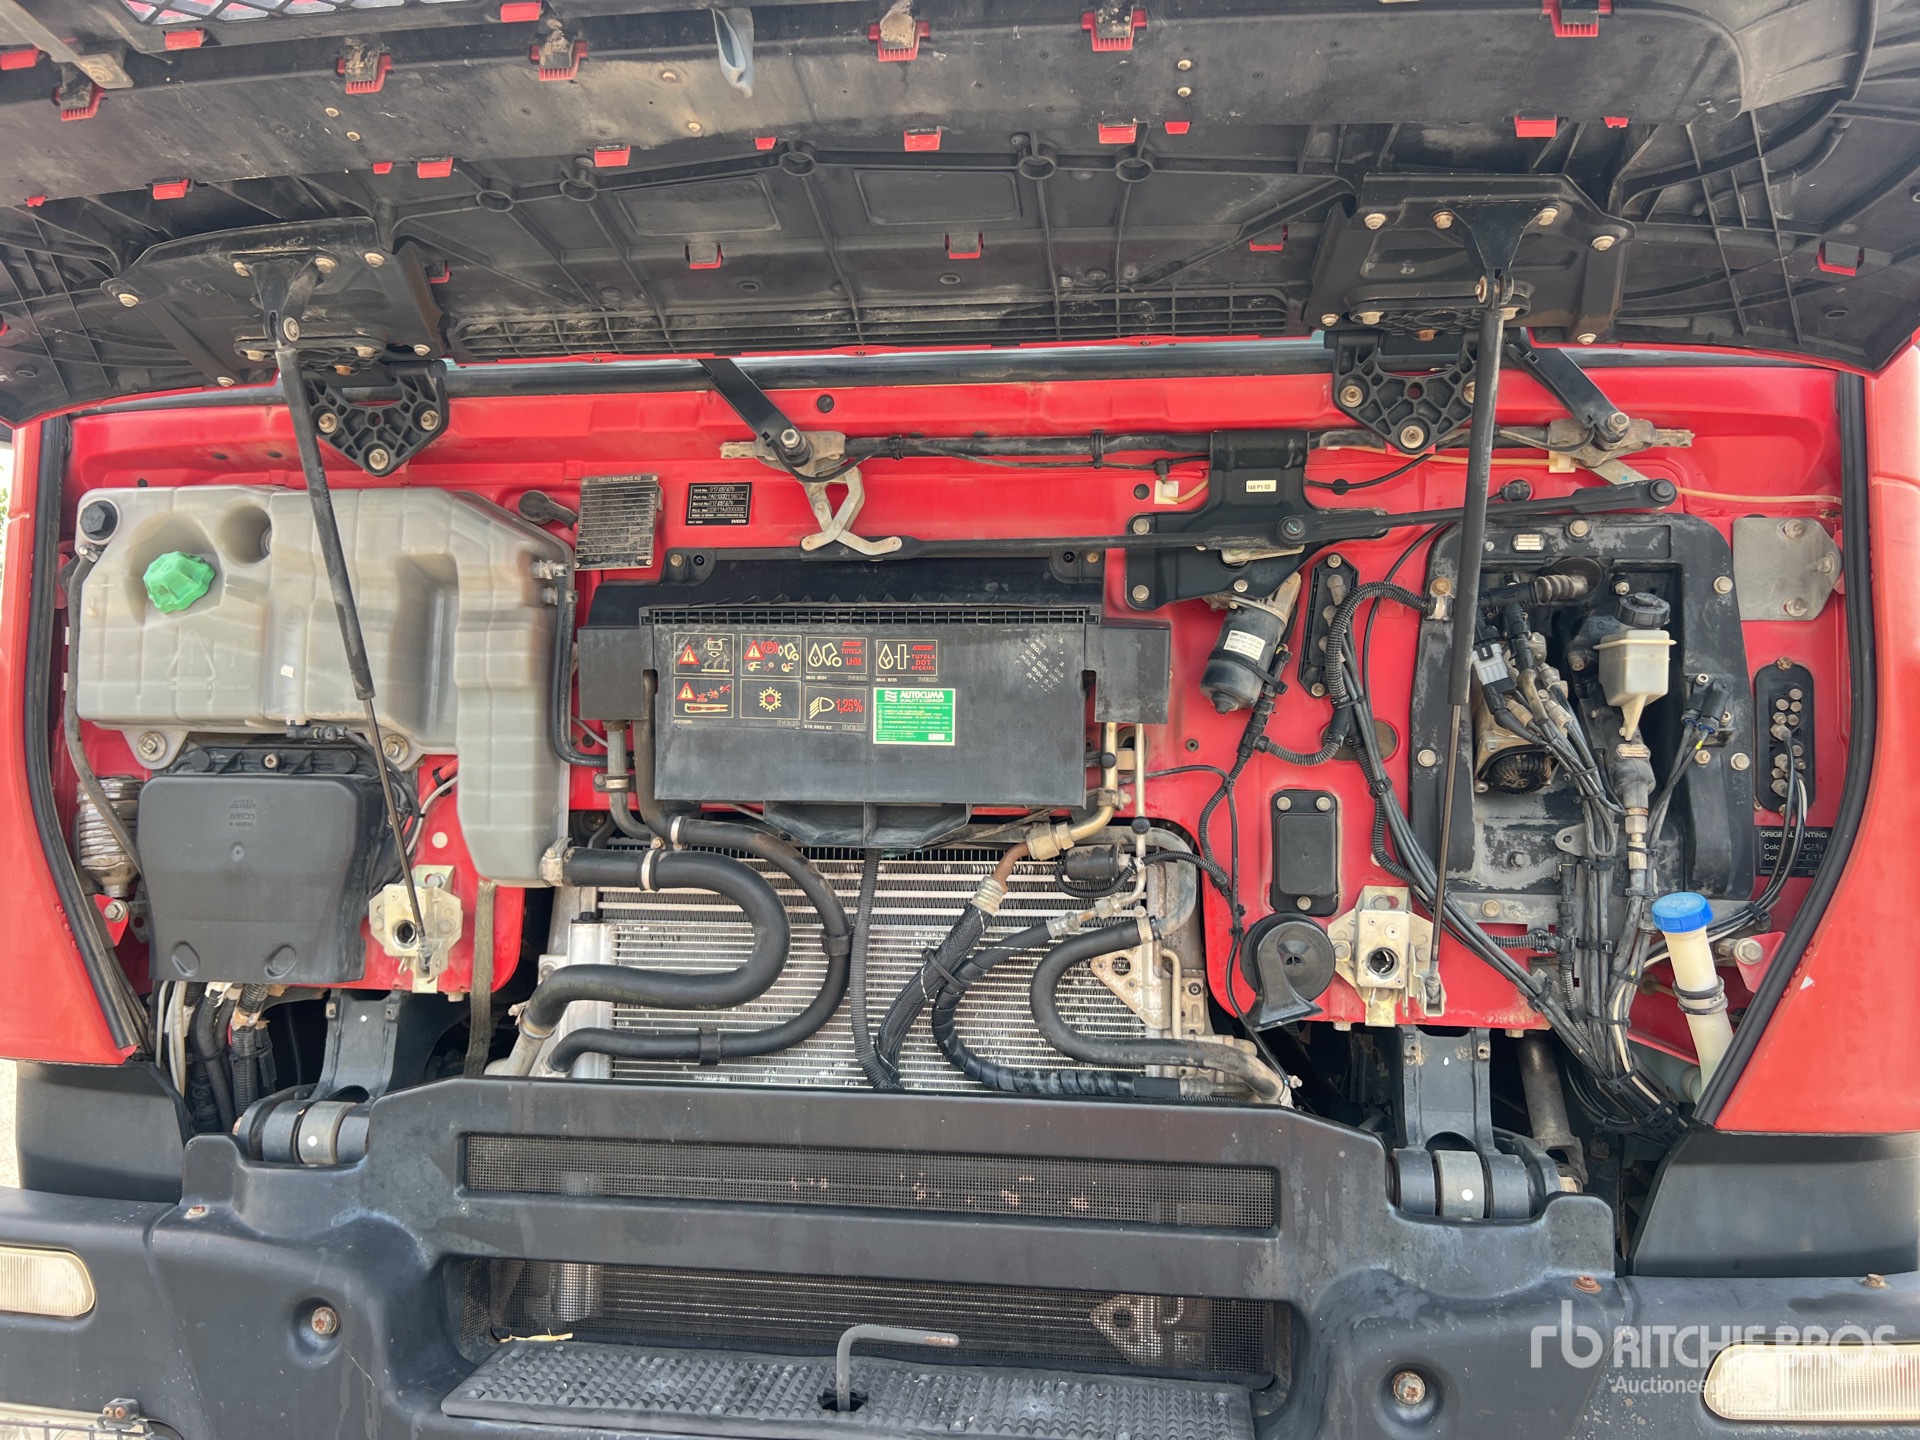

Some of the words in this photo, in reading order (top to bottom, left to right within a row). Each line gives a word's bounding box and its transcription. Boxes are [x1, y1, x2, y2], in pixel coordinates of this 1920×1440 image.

[846, 657, 862, 666] LHM
[900, 690, 944, 699] AUTOCLIMA
[836, 698, 864, 714] 1,25%
[230, 812, 255, 820] IVECO
